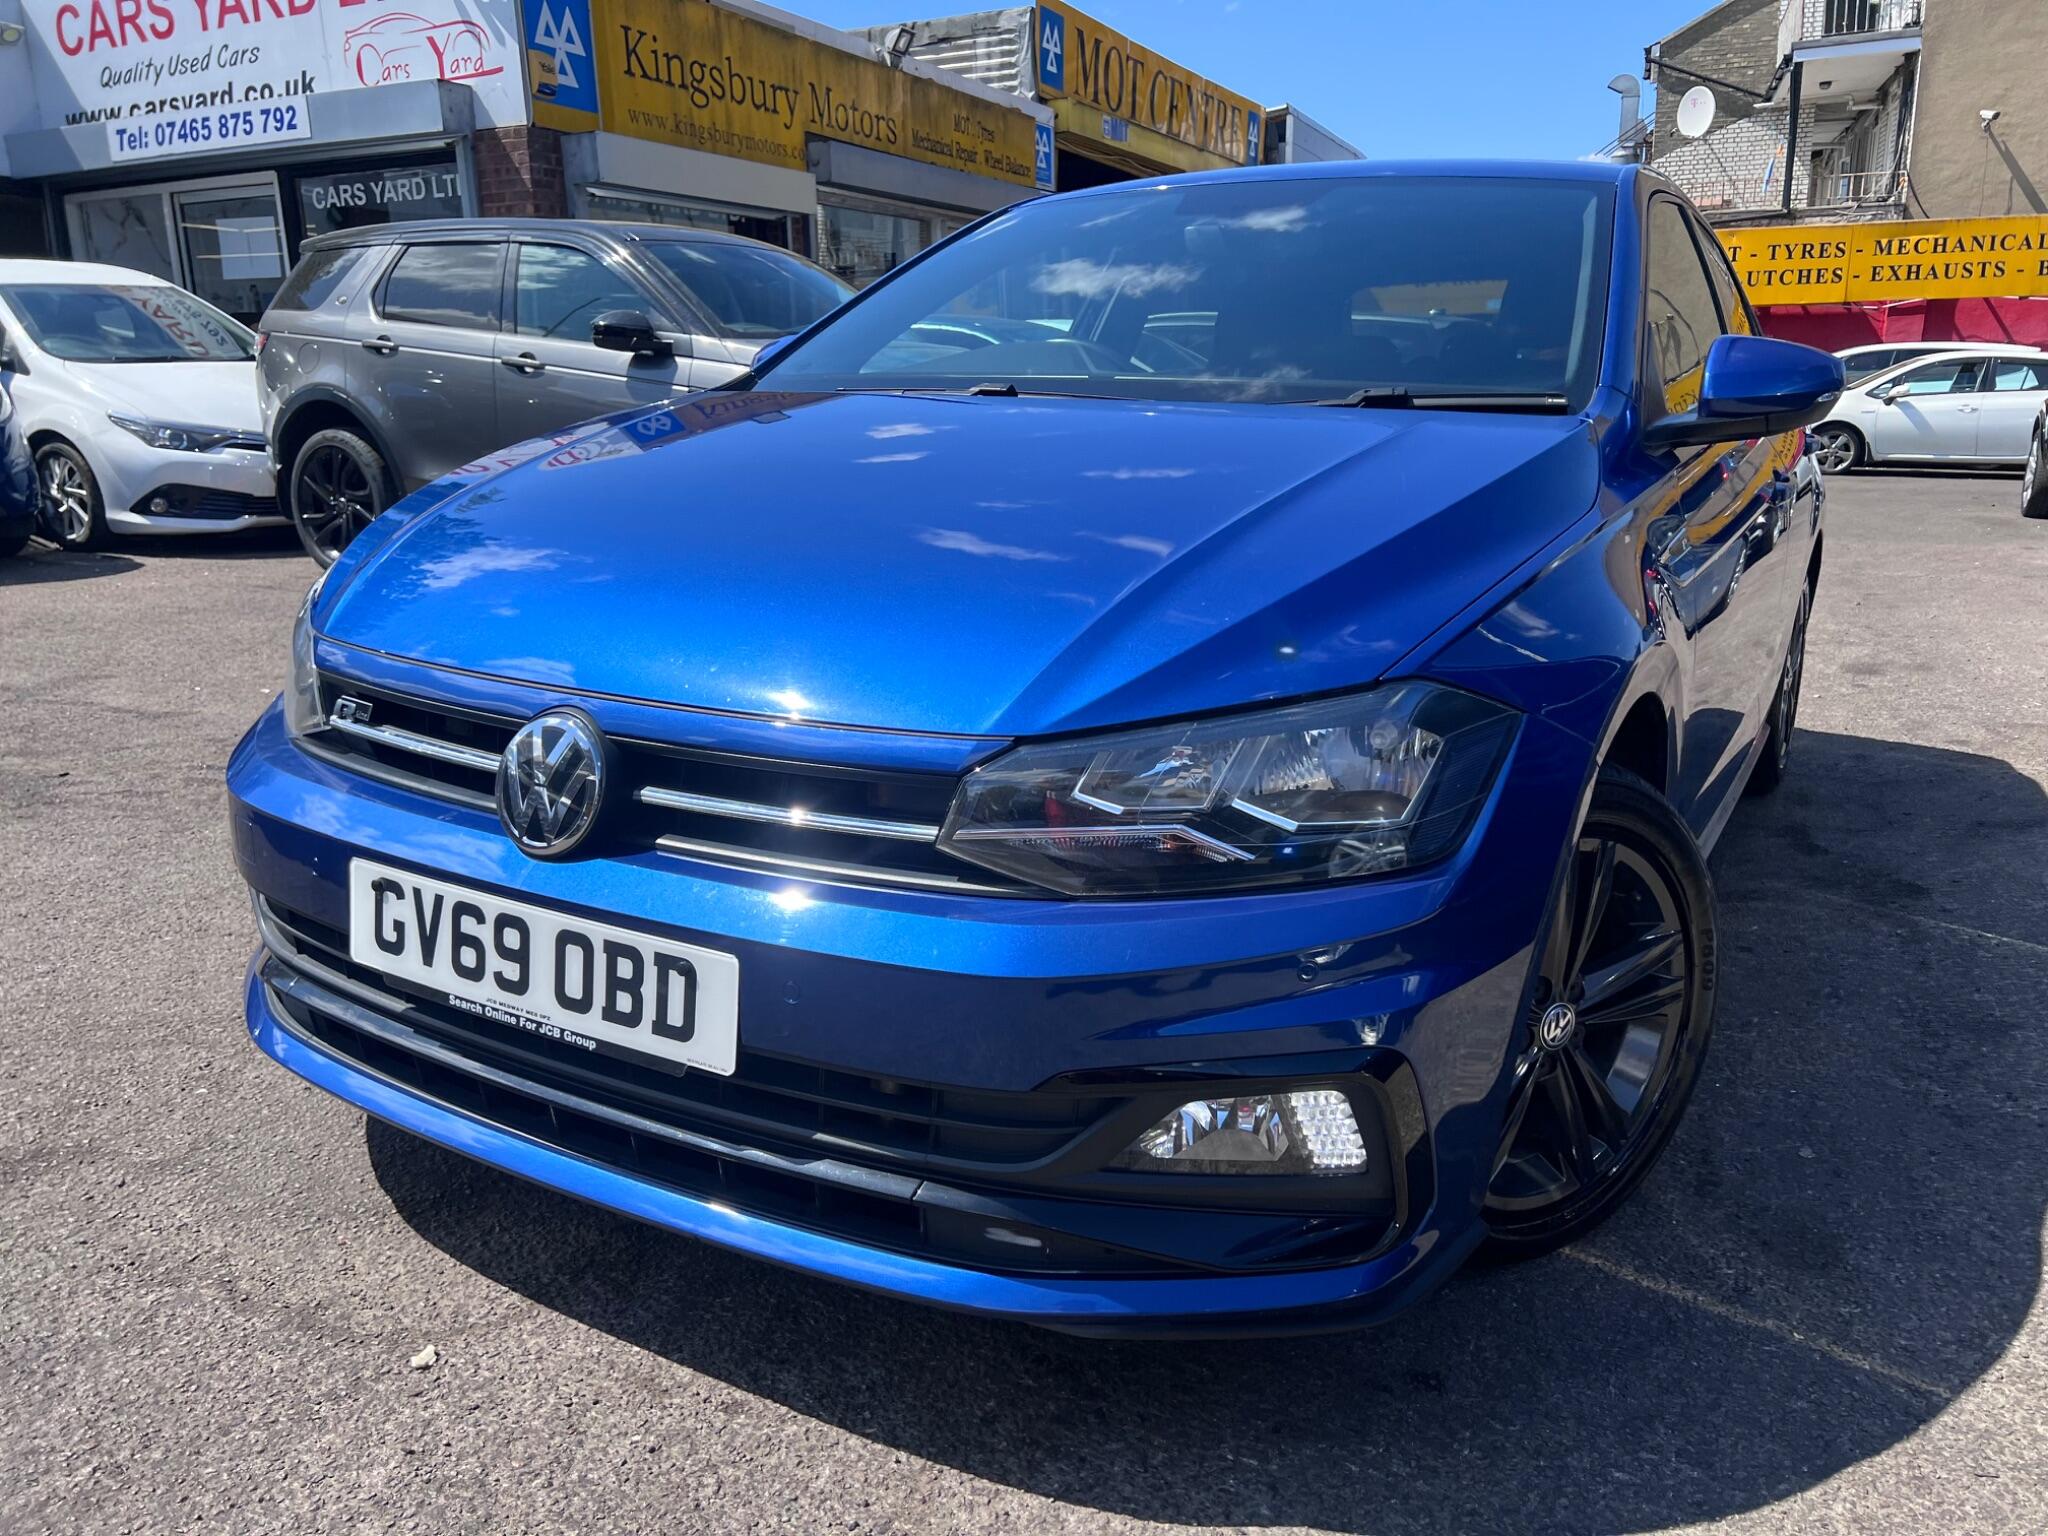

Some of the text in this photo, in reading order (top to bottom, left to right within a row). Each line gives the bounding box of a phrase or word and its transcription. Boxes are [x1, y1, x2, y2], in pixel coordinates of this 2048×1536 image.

[56, 0, 315, 56] CARS YA
[100, 44, 260, 88] Quality Used Cars
[357, 31, 492, 87] Cars Yard
[620, 24, 898, 145] Kingsbury Motors
[65, 70, 315, 125] wwwcarsard.co.uk
[1073, 27, 1243, 164] MOT CENTRE
[116, 104, 297, 151] Tel: 07465 875 792
[312, 181, 368, 209] CARS
[370, 177, 426, 204] YARD
[1742, 266, 1844, 287] UTCHES
[1869, 260, 2007, 282] EXHAUSTS
[1767, 241, 1847, 261] TYRES
[1873, 232, 2048, 257] MECHANICAL
[371, 876, 698, 1043] GV69 OBD
[449, 994, 597, 1051] Search Online For JCB Group
